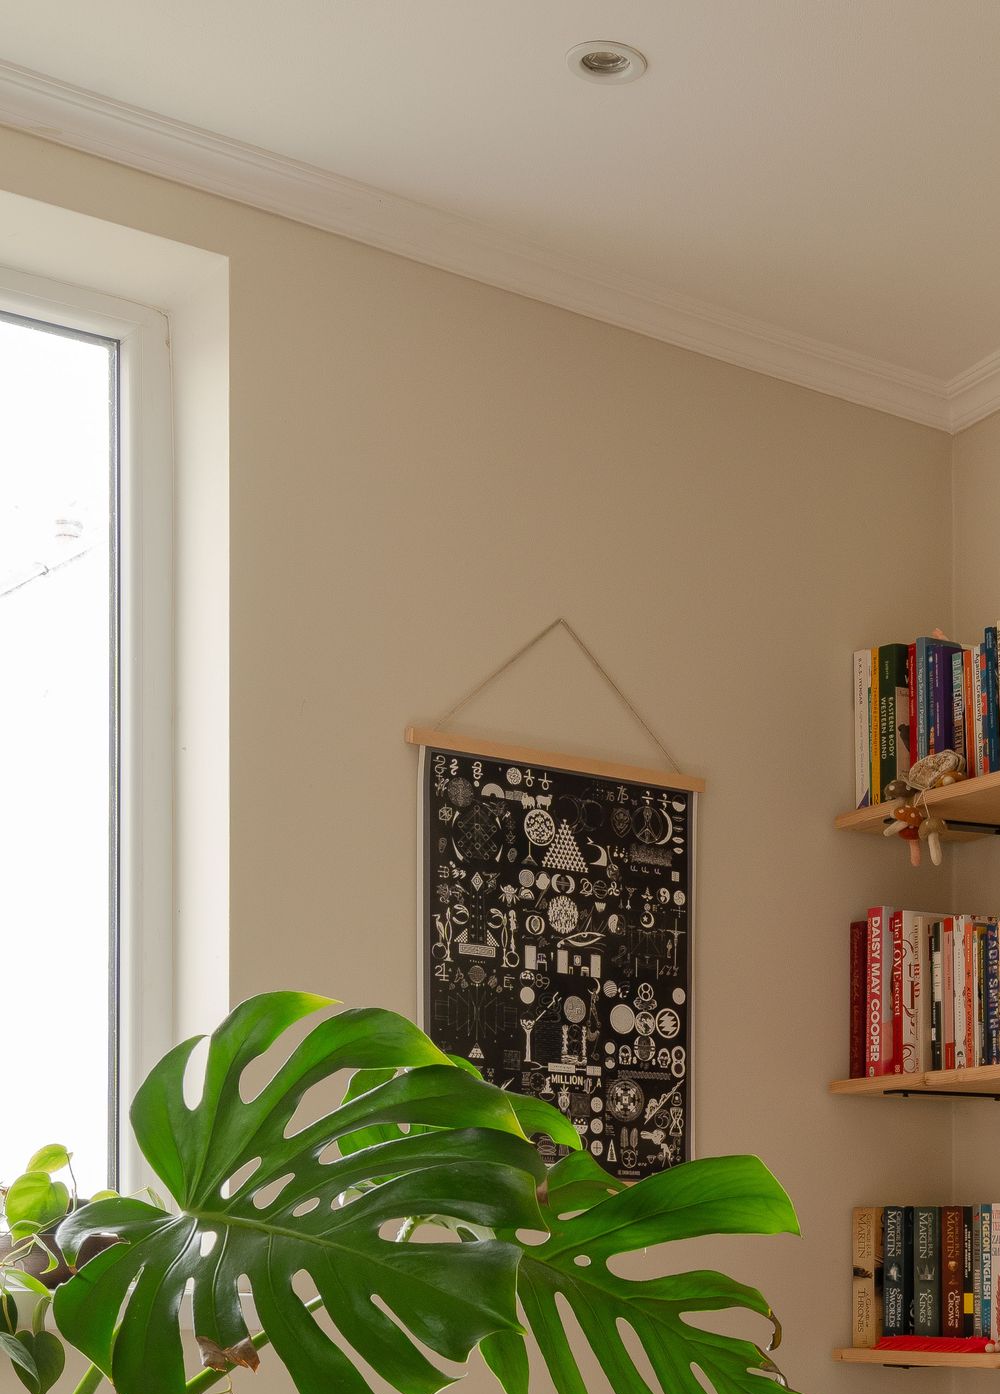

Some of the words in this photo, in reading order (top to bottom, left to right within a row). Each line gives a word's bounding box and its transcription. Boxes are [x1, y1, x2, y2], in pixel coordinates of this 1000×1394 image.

[952, 659, 962, 686] BLACK
[952, 688, 962, 720] TEACHER
[872, 916, 880, 960] DAISY
[871, 962, 880, 995] MAY
[894, 940, 902, 982] LOVE
[870, 998, 880, 1062] COOPER
[551, 1074, 584, 1086] MILLION
[888, 1210, 896, 1256] MARTIN
[919, 1212, 928, 1258] MARTIN
[982, 1213, 990, 1252] PIGEON
[984, 1253, 992, 1300] ENGLISH
[858, 1288, 866, 1332] THRONES
[888, 1287, 897, 1328] SWORDS
[919, 1292, 928, 1323] KINGS
